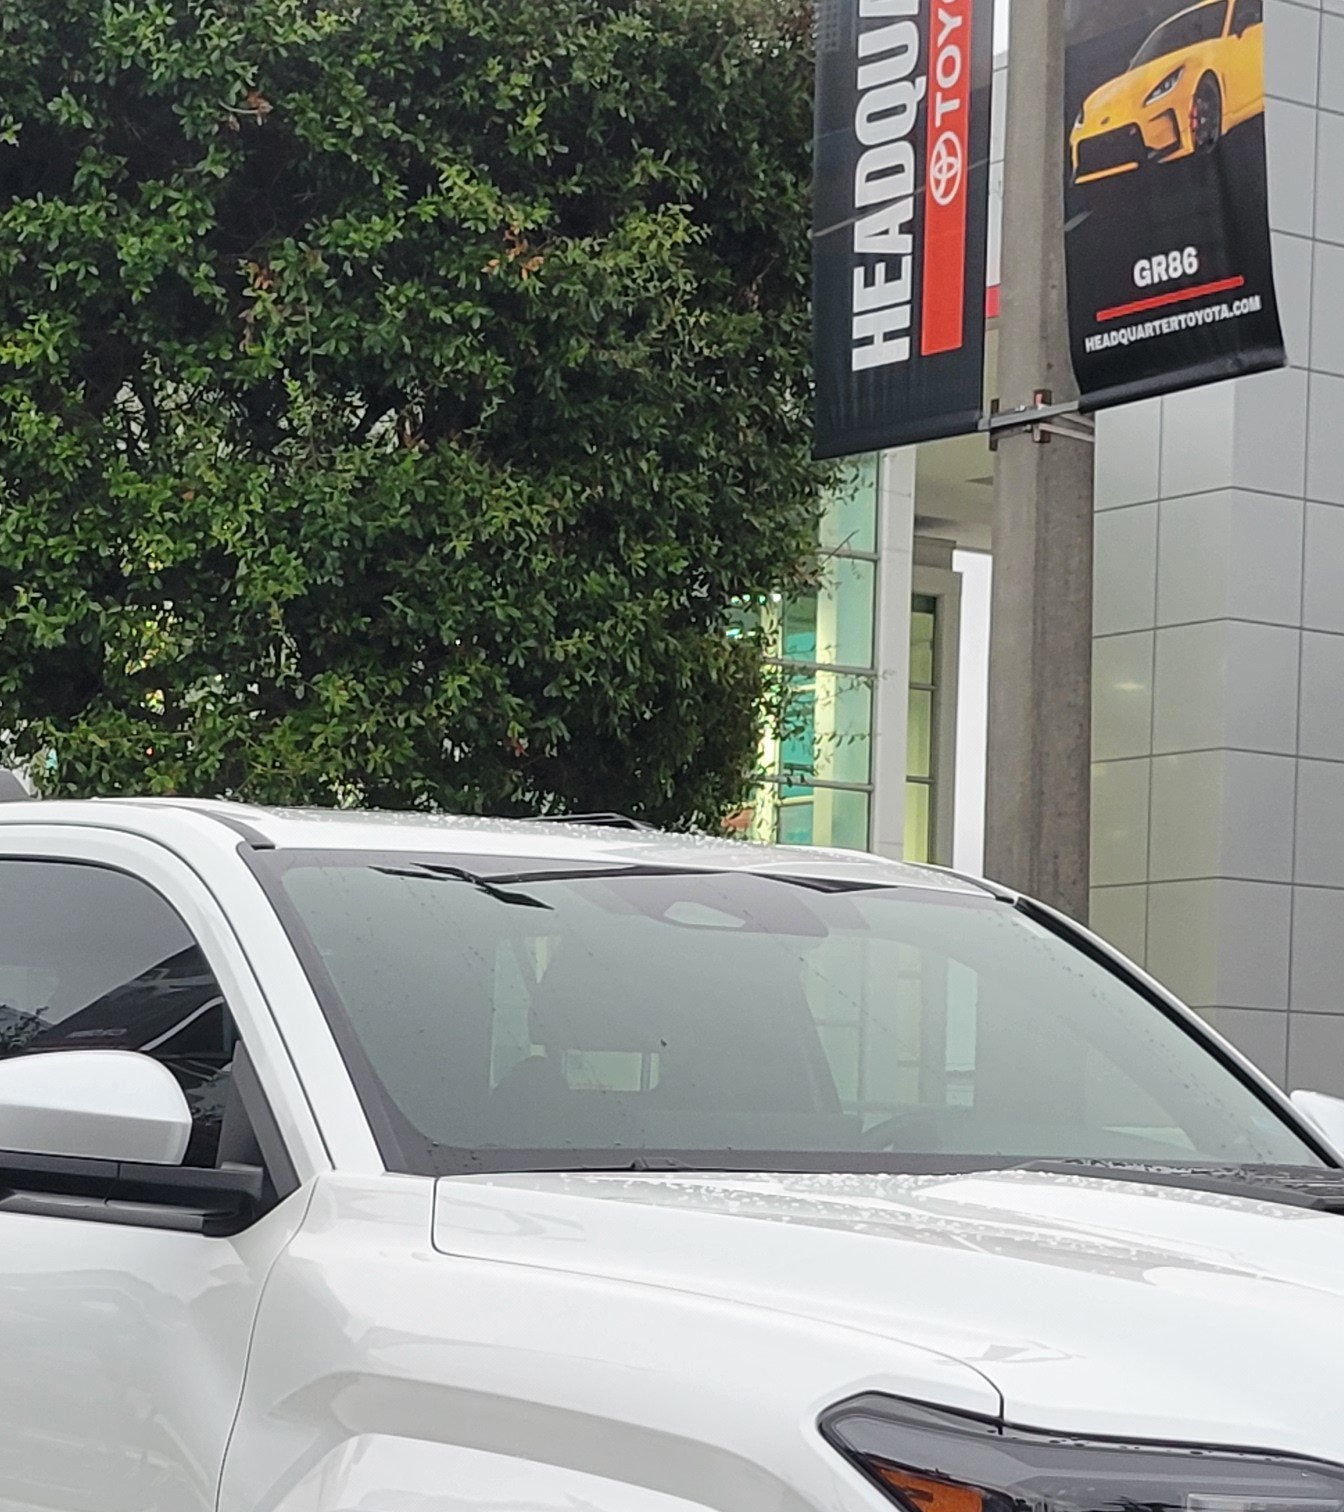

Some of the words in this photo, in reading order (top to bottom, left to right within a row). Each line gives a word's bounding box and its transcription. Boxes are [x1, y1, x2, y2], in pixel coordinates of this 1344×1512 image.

[935, 0, 963, 128] TOY
[1133, 246, 1199, 288] GR86
[1084, 294, 1263, 353] HEADQUARTERTOYOTA.COM
